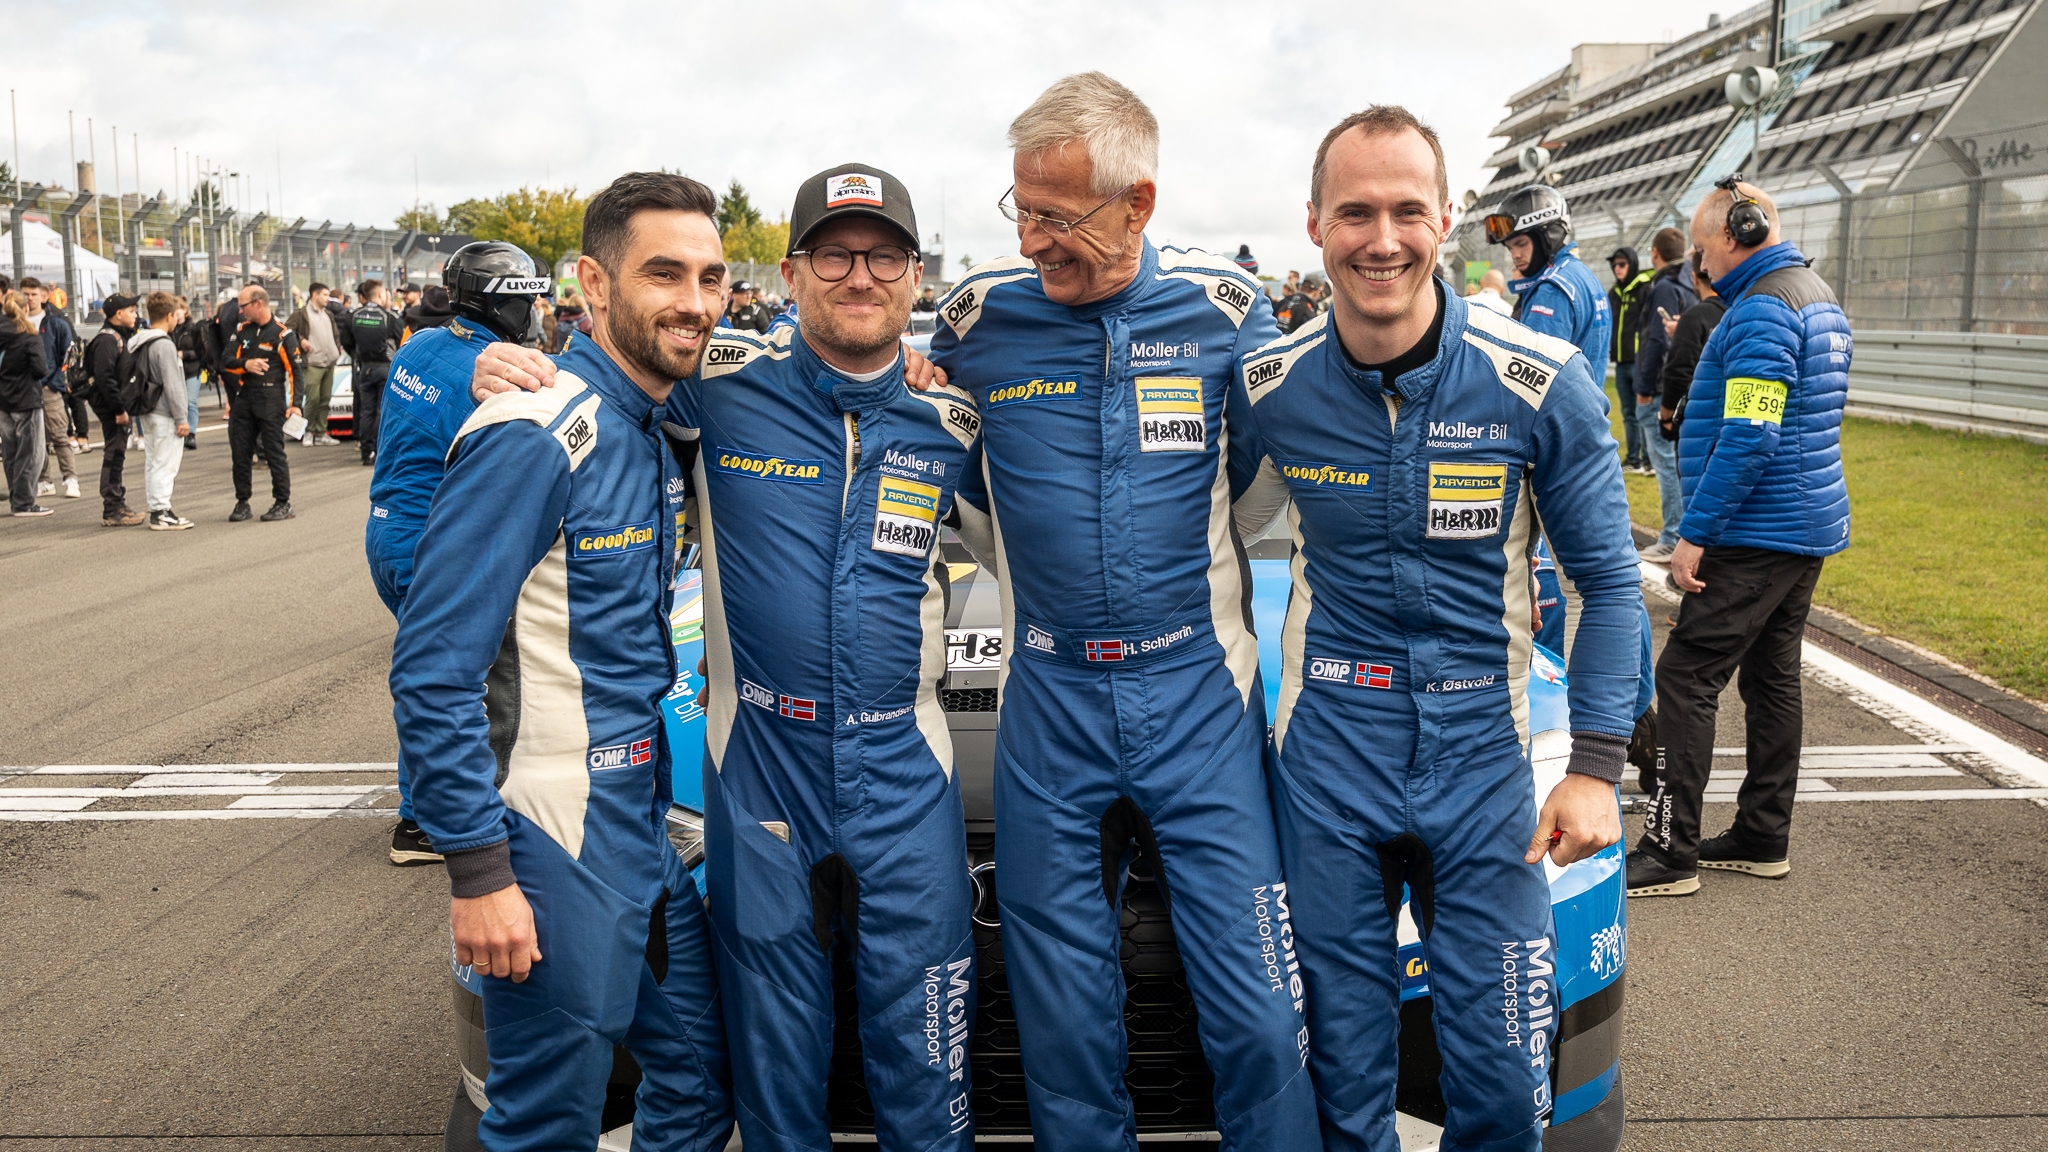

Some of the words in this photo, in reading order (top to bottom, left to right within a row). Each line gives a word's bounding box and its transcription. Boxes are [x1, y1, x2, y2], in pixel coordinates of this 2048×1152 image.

[833, 187, 876, 198] alpinestars
[1522, 208, 1559, 225] uvex
[506, 280, 547, 291] uvex
[1217, 283, 1249, 309] OMP
[948, 291, 975, 322] OMP
[708, 348, 747, 362] OMP
[1183, 343, 1199, 358] Bil
[1130, 360, 1171, 368] Motorsport
[1248, 361, 1283, 386] OMP
[1507, 361, 1547, 388] OMP
[423, 384, 442, 405] Bil
[1146, 391, 1195, 399] RAVENOL
[1756, 383, 1771, 393] PIT
[950, 408, 978, 432] OMP
[567, 419, 589, 450] OMP
[1489, 424, 1508, 440] Bil
[1426, 440, 1473, 449] Motorsport
[878, 464, 920, 480] Motorsport
[932, 460, 946, 477] Bil
[1439, 478, 1496, 487] RAVENOL
[888, 491, 933, 507] RAVENOL
[1026, 630, 1055, 650] OMP
[1123, 643, 1138, 655] H.
[1310, 661, 1350, 679] OMP
[1426, 682, 1440, 693] K.
[1442, 675, 1495, 692] Østvold
[742, 683, 775, 707] OMP
[846, 714, 858, 726] A.
[590, 749, 626, 768] OMP
[1656, 747, 1666, 770] Bil
[1252, 885, 1284, 993] Motorsport
[1502, 941, 1522, 1049] Motorsport
[923, 965, 942, 1066] Motorsport
[1533, 1081, 1553, 1124] Bil
[950, 1091, 971, 1135] Bil
